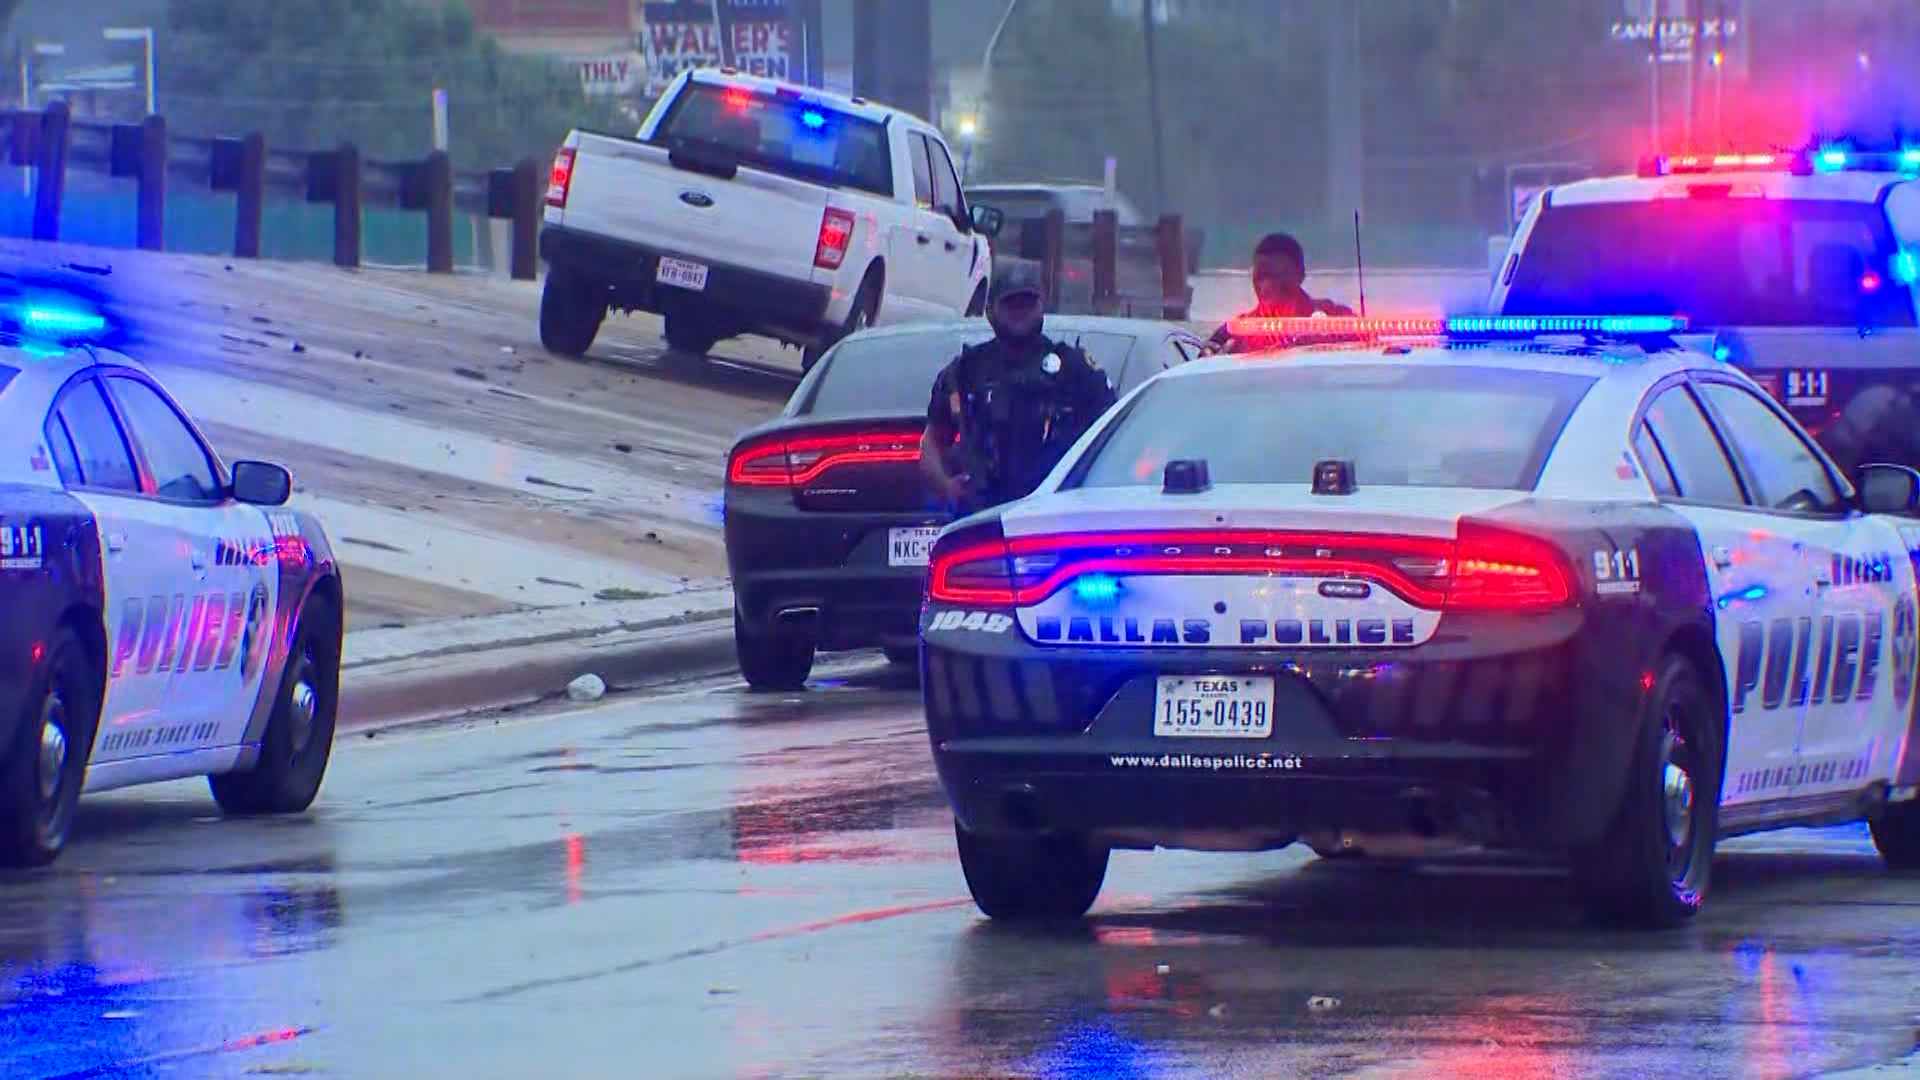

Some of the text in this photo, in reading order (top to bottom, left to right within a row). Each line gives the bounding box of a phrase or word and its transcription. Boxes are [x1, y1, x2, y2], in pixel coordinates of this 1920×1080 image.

[650, 23, 790, 53] WALER'S
[660, 53, 788, 80] KITHEN
[111, 592, 246, 678] POLICE
[1036, 618, 1415, 645] DALLAS POLICE
[1732, 613, 1882, 713] POLICE
[1195, 681, 1238, 692] TEXAS
[1110, 755, 1303, 771] www.dallaspolice.net
